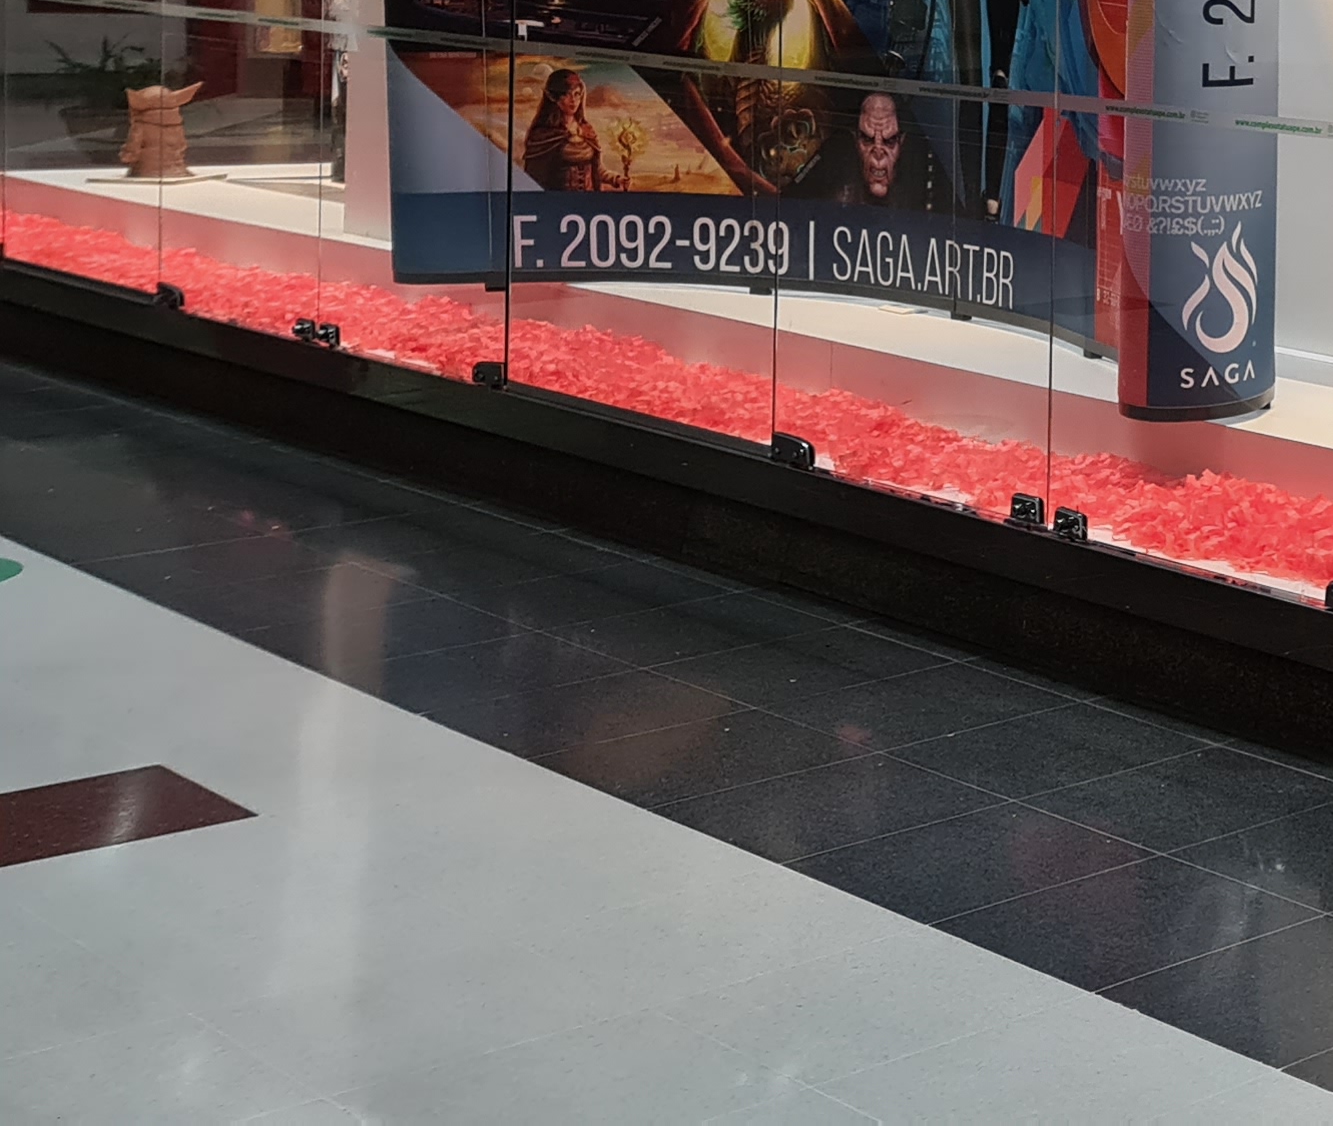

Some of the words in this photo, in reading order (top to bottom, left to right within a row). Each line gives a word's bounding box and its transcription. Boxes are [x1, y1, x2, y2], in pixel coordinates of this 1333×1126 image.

[1201, 52, 1256, 89] F.
[512, 214, 543, 269] F.
[560, 213, 790, 275] 2092-9239
[832, 225, 1014, 310] SAGA.ART.BR
[1180, 359, 1256, 389] SAGA
